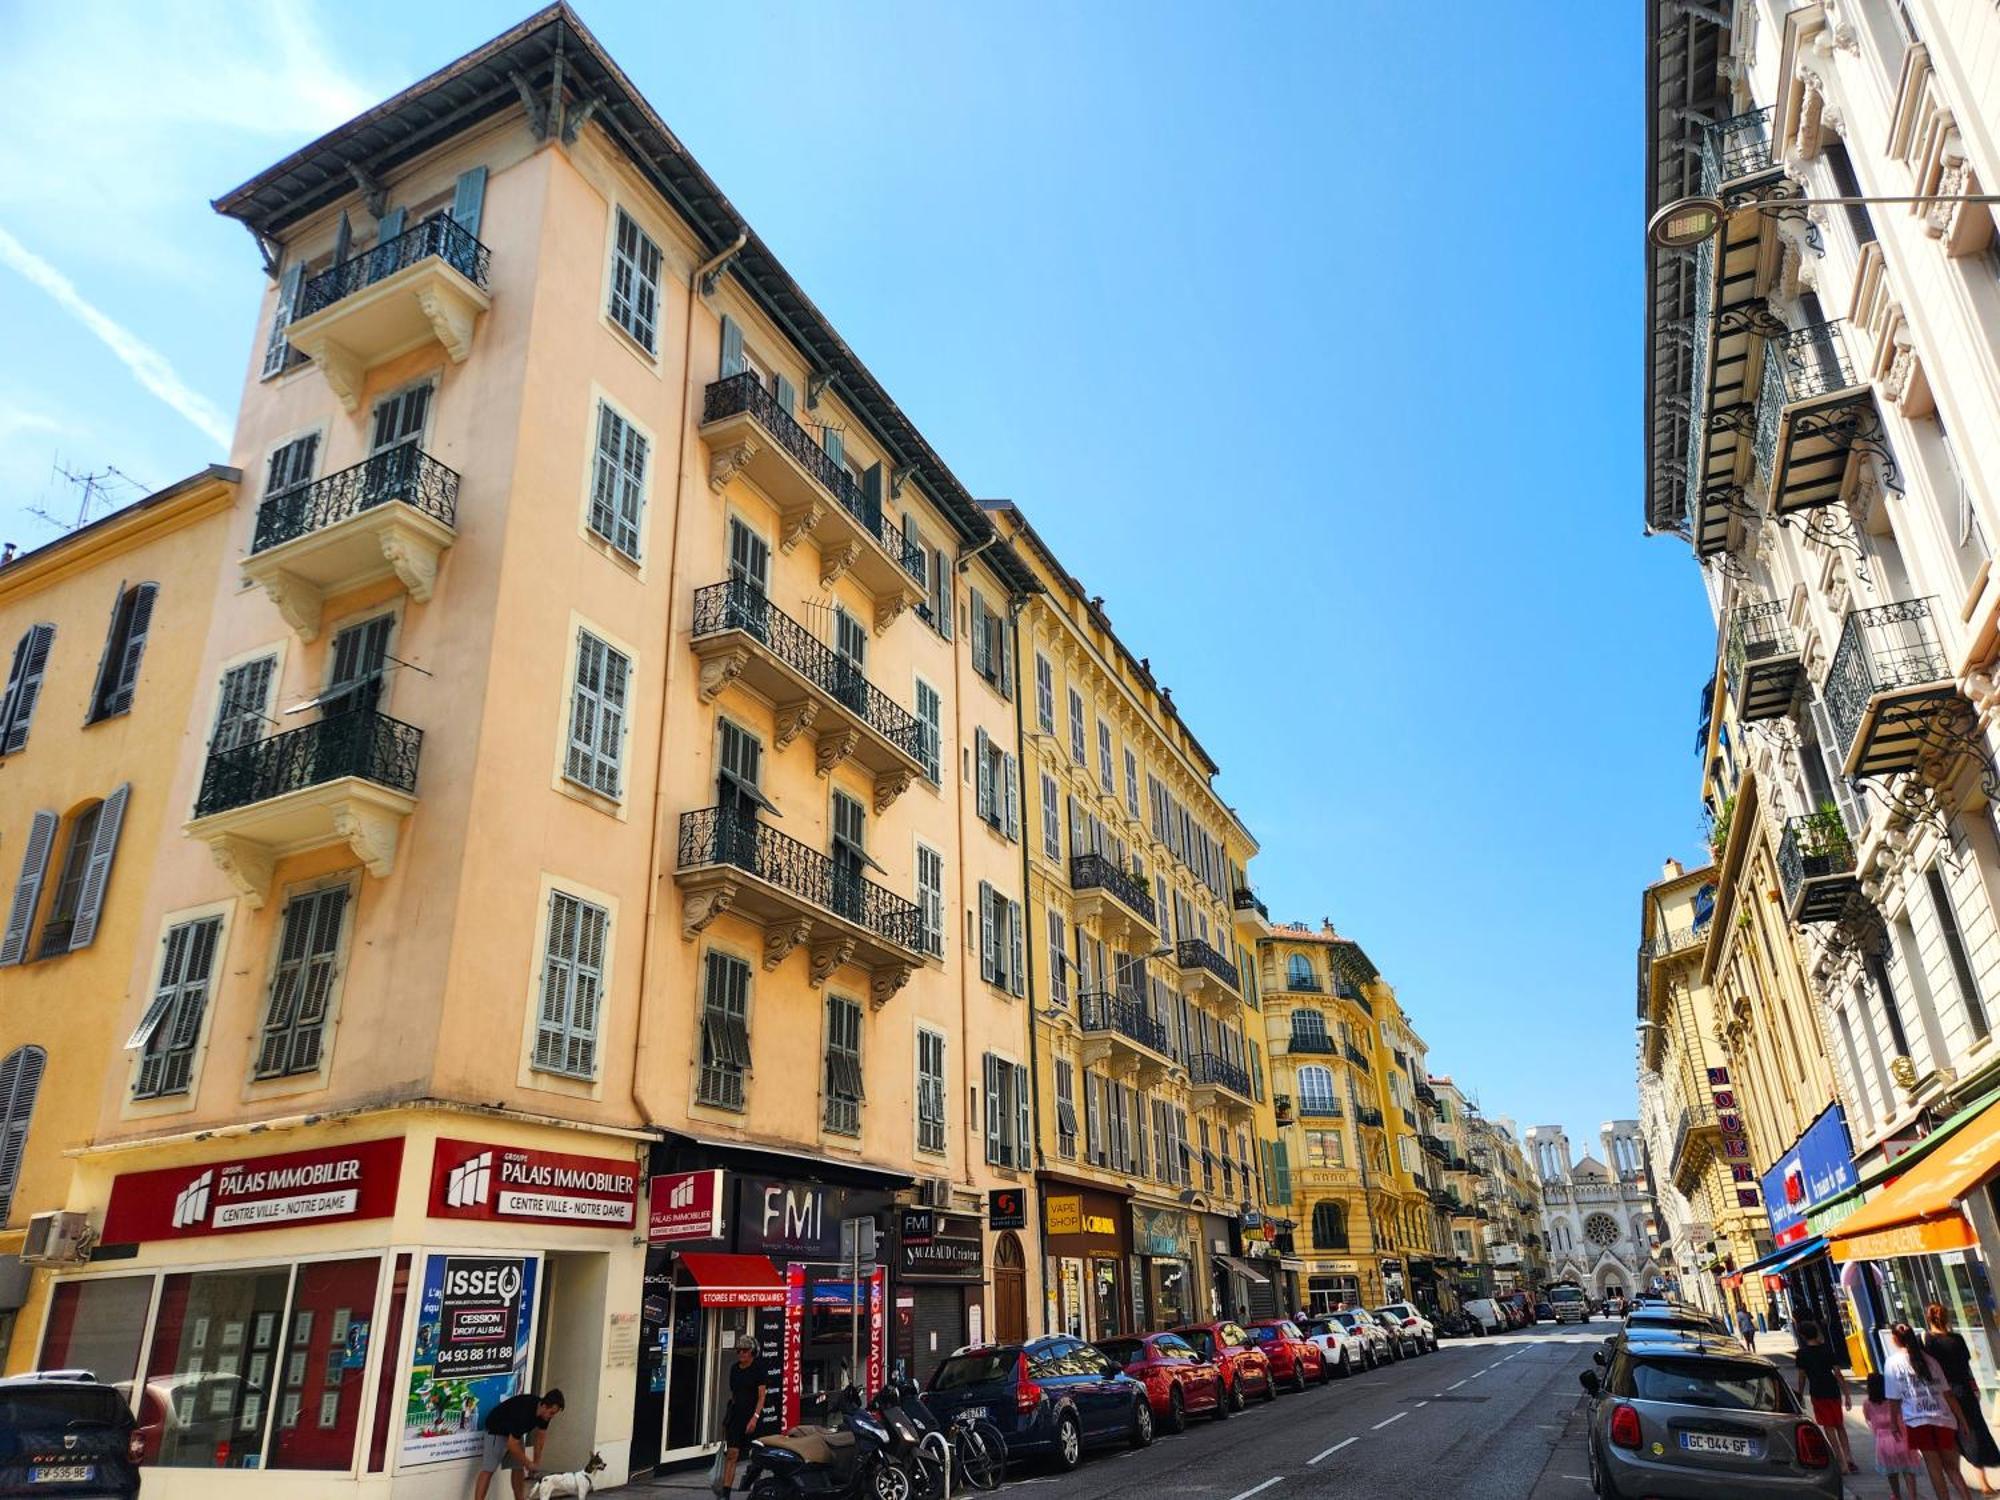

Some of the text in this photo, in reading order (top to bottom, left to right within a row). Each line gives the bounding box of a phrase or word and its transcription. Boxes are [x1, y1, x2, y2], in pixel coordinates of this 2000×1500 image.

[1708, 1067, 1759, 1207] JOUETS
[218, 1159, 361, 1196] PALAIS IMMOBILIER
[502, 1162, 634, 1194] PALAIS IMMOBILIER
[222, 1206, 255, 1222] CENTRE
[256, 1203, 280, 1217] VILLE
[286, 1201, 316, 1215] NOTRE
[318, 1195, 346, 1211] DAME
[510, 1197, 543, 1211] CENTRE
[545, 1201, 567, 1213] VILLE
[575, 1203, 601, 1215] NOTRE
[603, 1204, 625, 1217] DAME
[763, 1187, 822, 1240] FMI
[1051, 1203, 1076, 1213] VAPE
[905, 1216, 929, 1230] FMI
[1050, 1216, 1078, 1227] SHOP
[703, 1291, 785, 1302] STORES ET MOUSTIQUAIRES
[460, 1314, 501, 1324] CESSION
[453, 1327, 476, 1335] DROIT
[488, 1325, 505, 1333] BAIL
[793, 1321, 801, 1343] 24
[870, 1280, 882, 1394] HOWROOM
[438, 1346, 513, 1363] 04 93 88 11 88
[793, 1350, 801, 1393] sous
[1689, 1435, 1747, 1452] GC-044-GF
